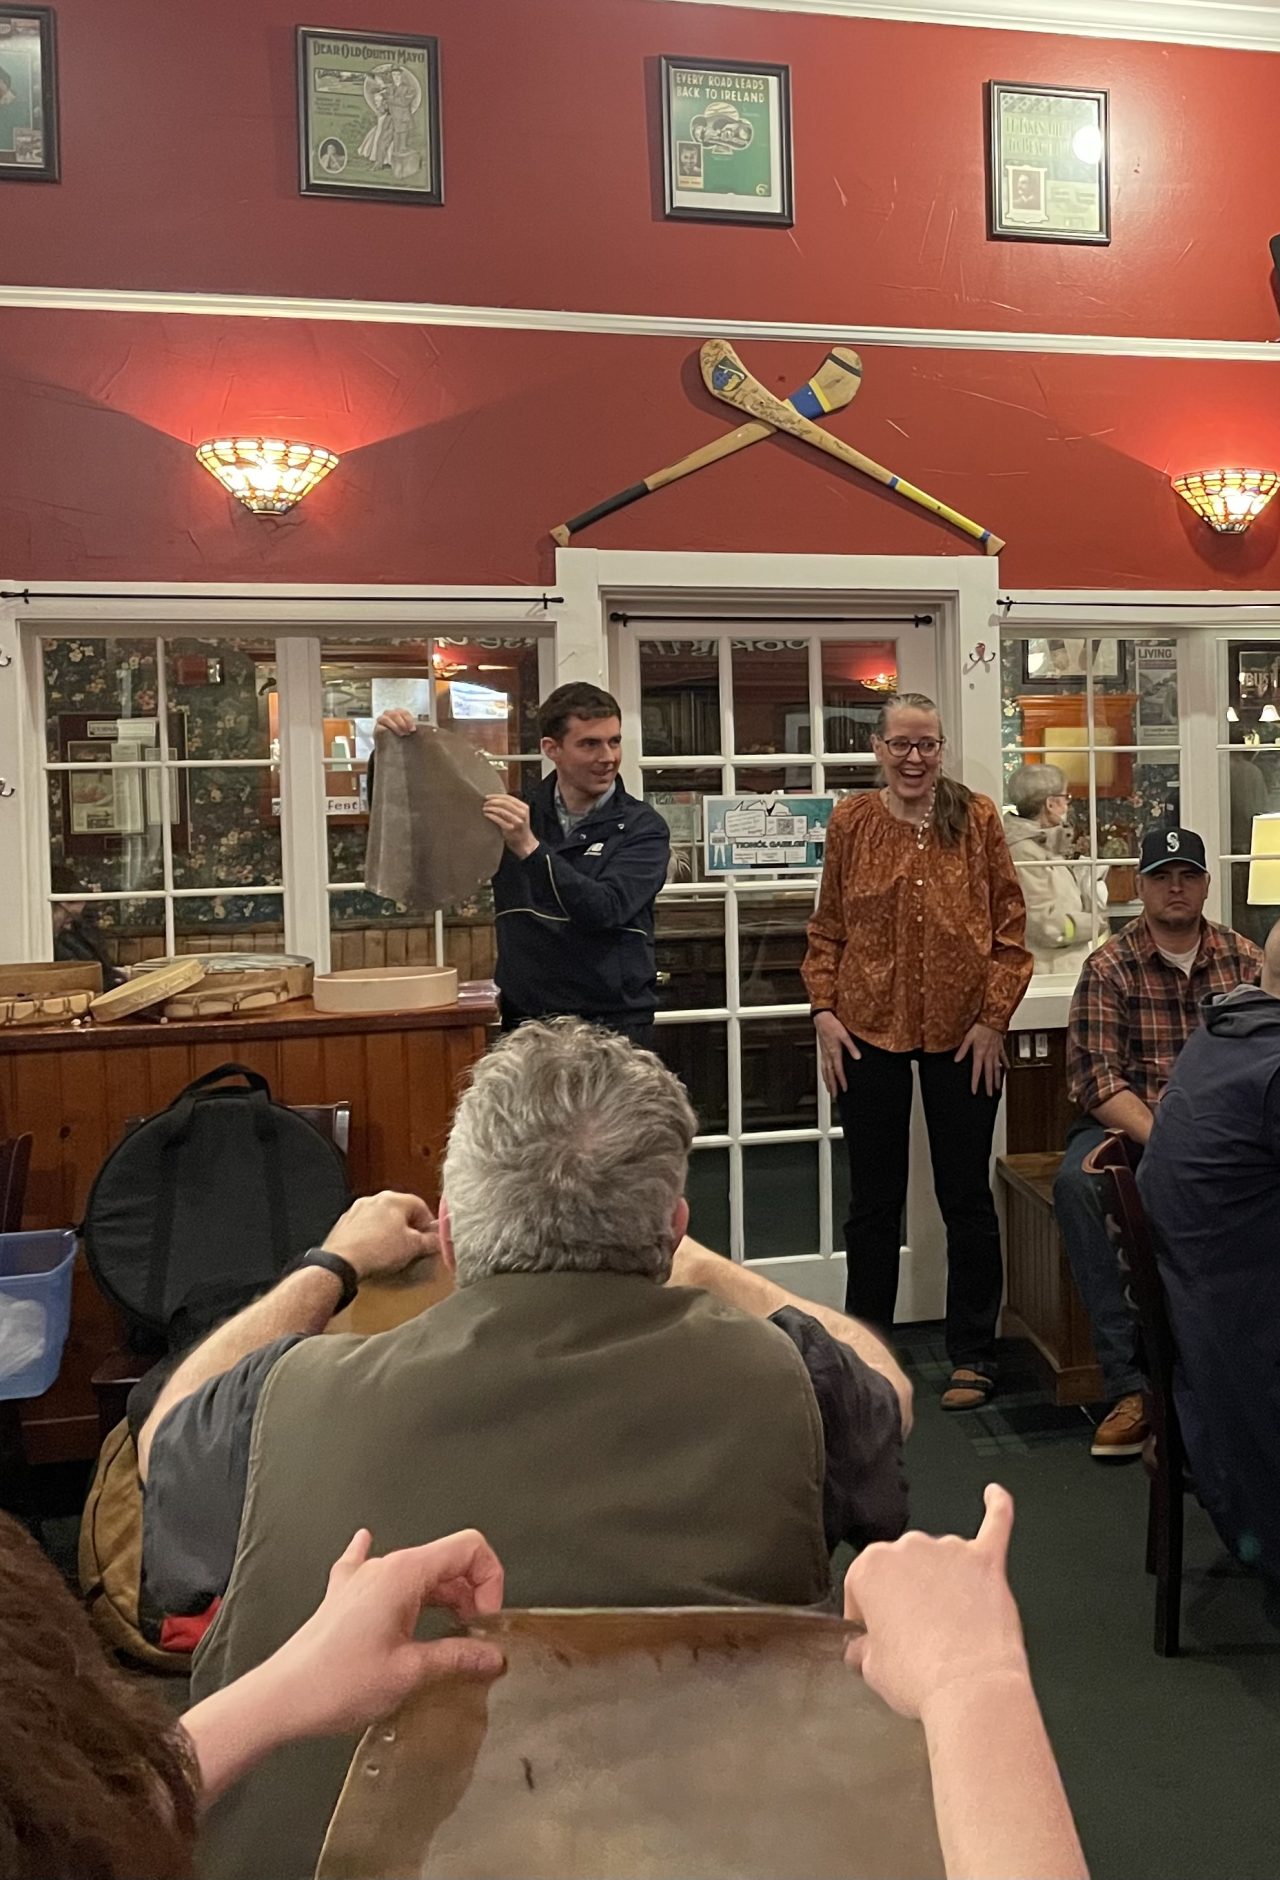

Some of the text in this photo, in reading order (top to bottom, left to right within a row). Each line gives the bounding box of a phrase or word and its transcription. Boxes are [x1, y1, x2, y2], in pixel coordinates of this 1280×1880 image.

[676, 73, 764, 90] EVERY ROAD LEADS
[676, 86, 765, 103] BACK TO IRELAND
[1138, 648, 1172, 659] LIVING
[1166, 831, 1180, 852] S
